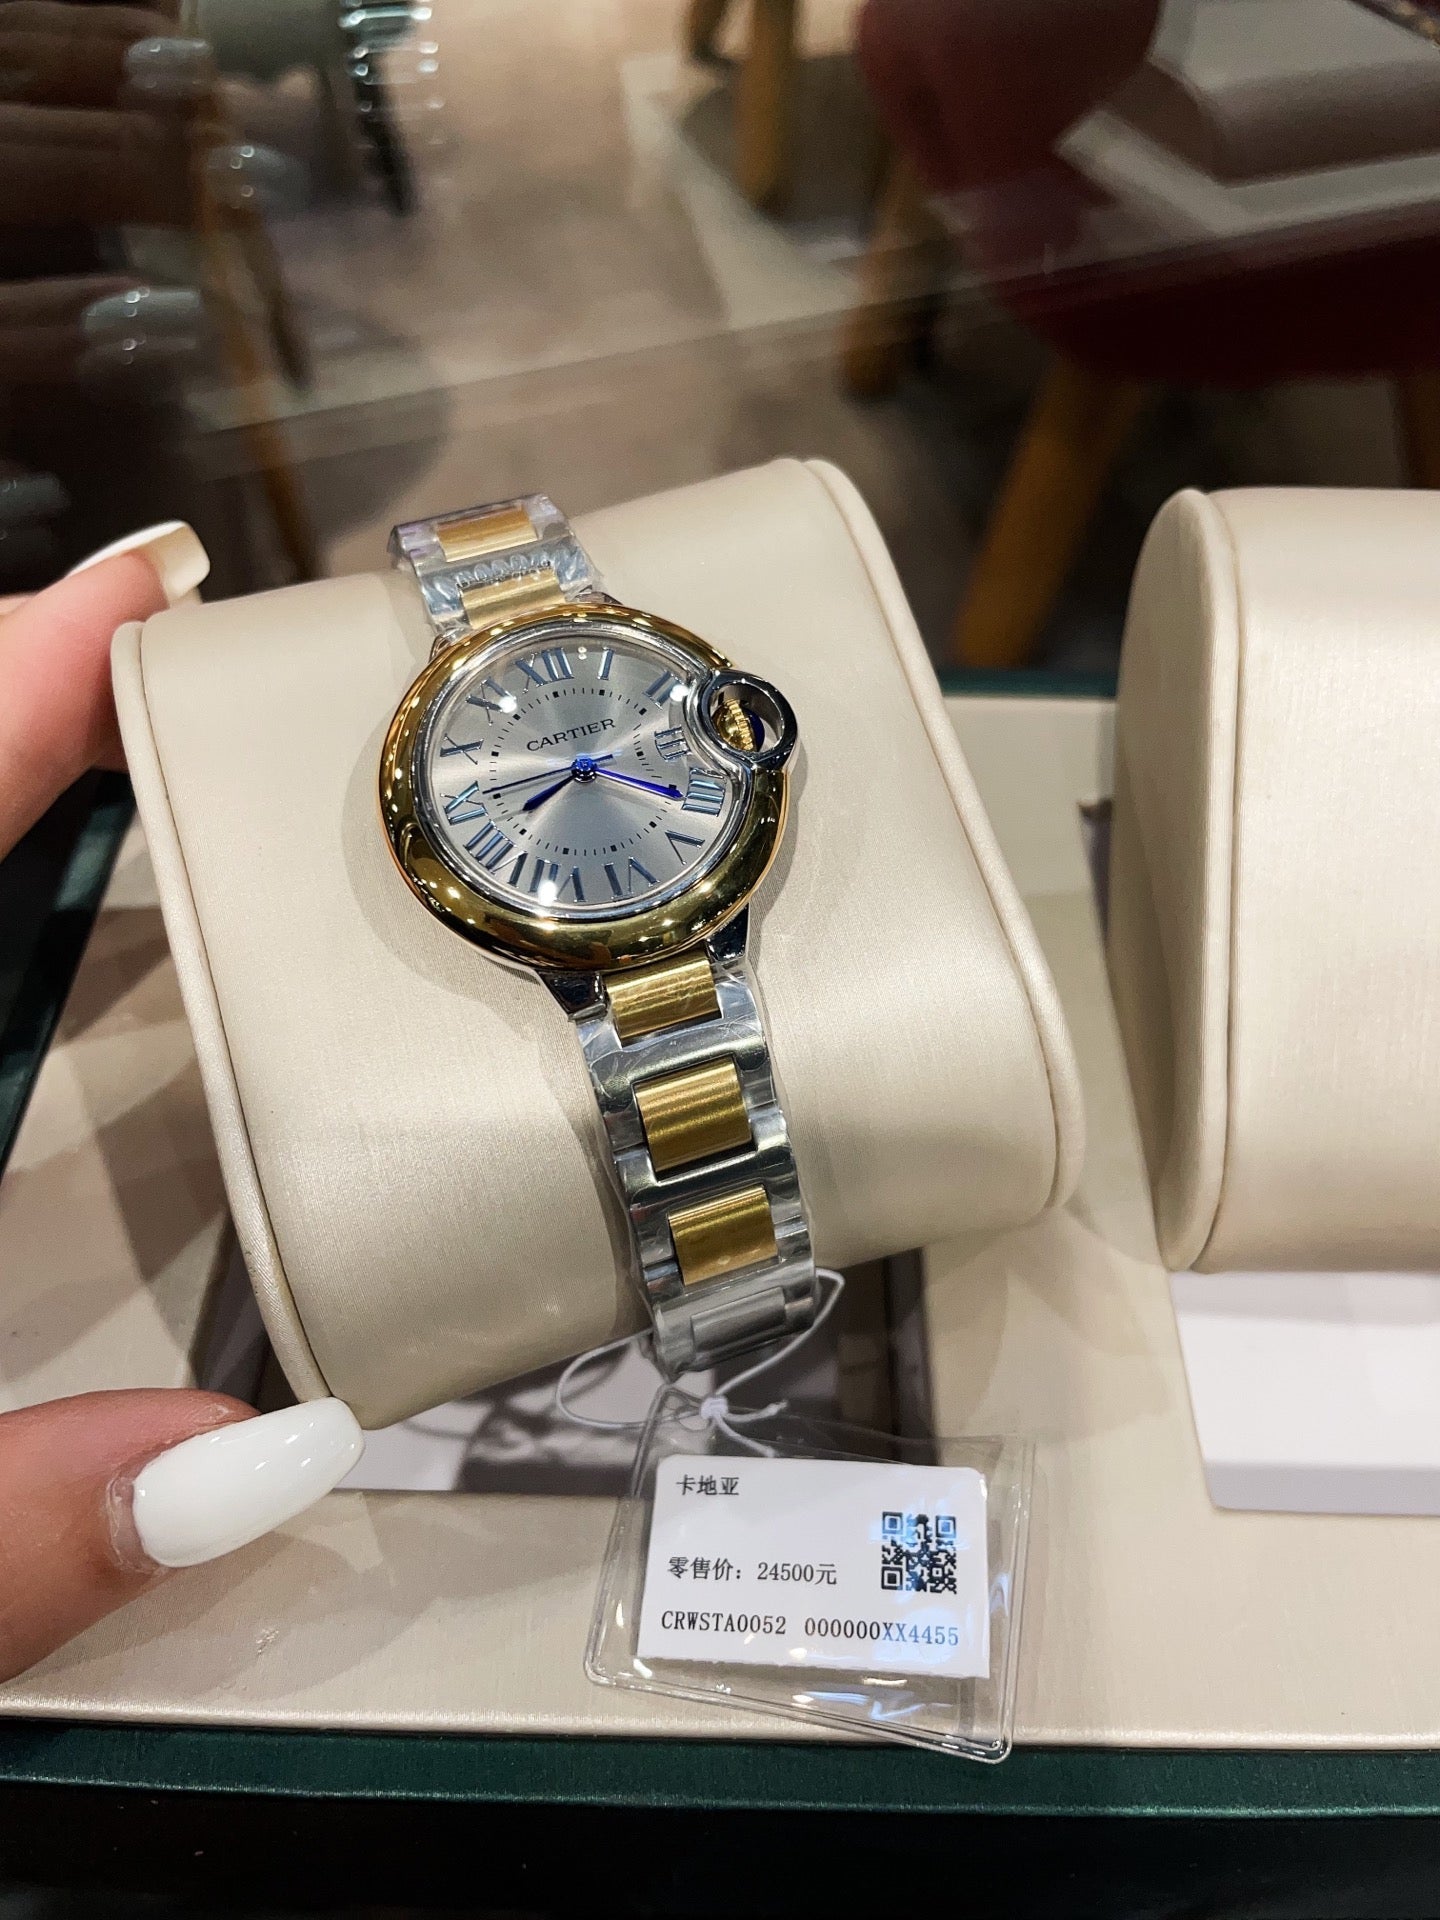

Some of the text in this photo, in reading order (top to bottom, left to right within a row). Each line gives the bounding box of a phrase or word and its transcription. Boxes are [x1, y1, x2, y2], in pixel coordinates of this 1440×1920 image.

[526, 718, 616, 751] CARTIER
[676, 1475, 740, 1497] 卡地亚
[661, 1610, 959, 1646] CRWSTA0052 000000XX4455
